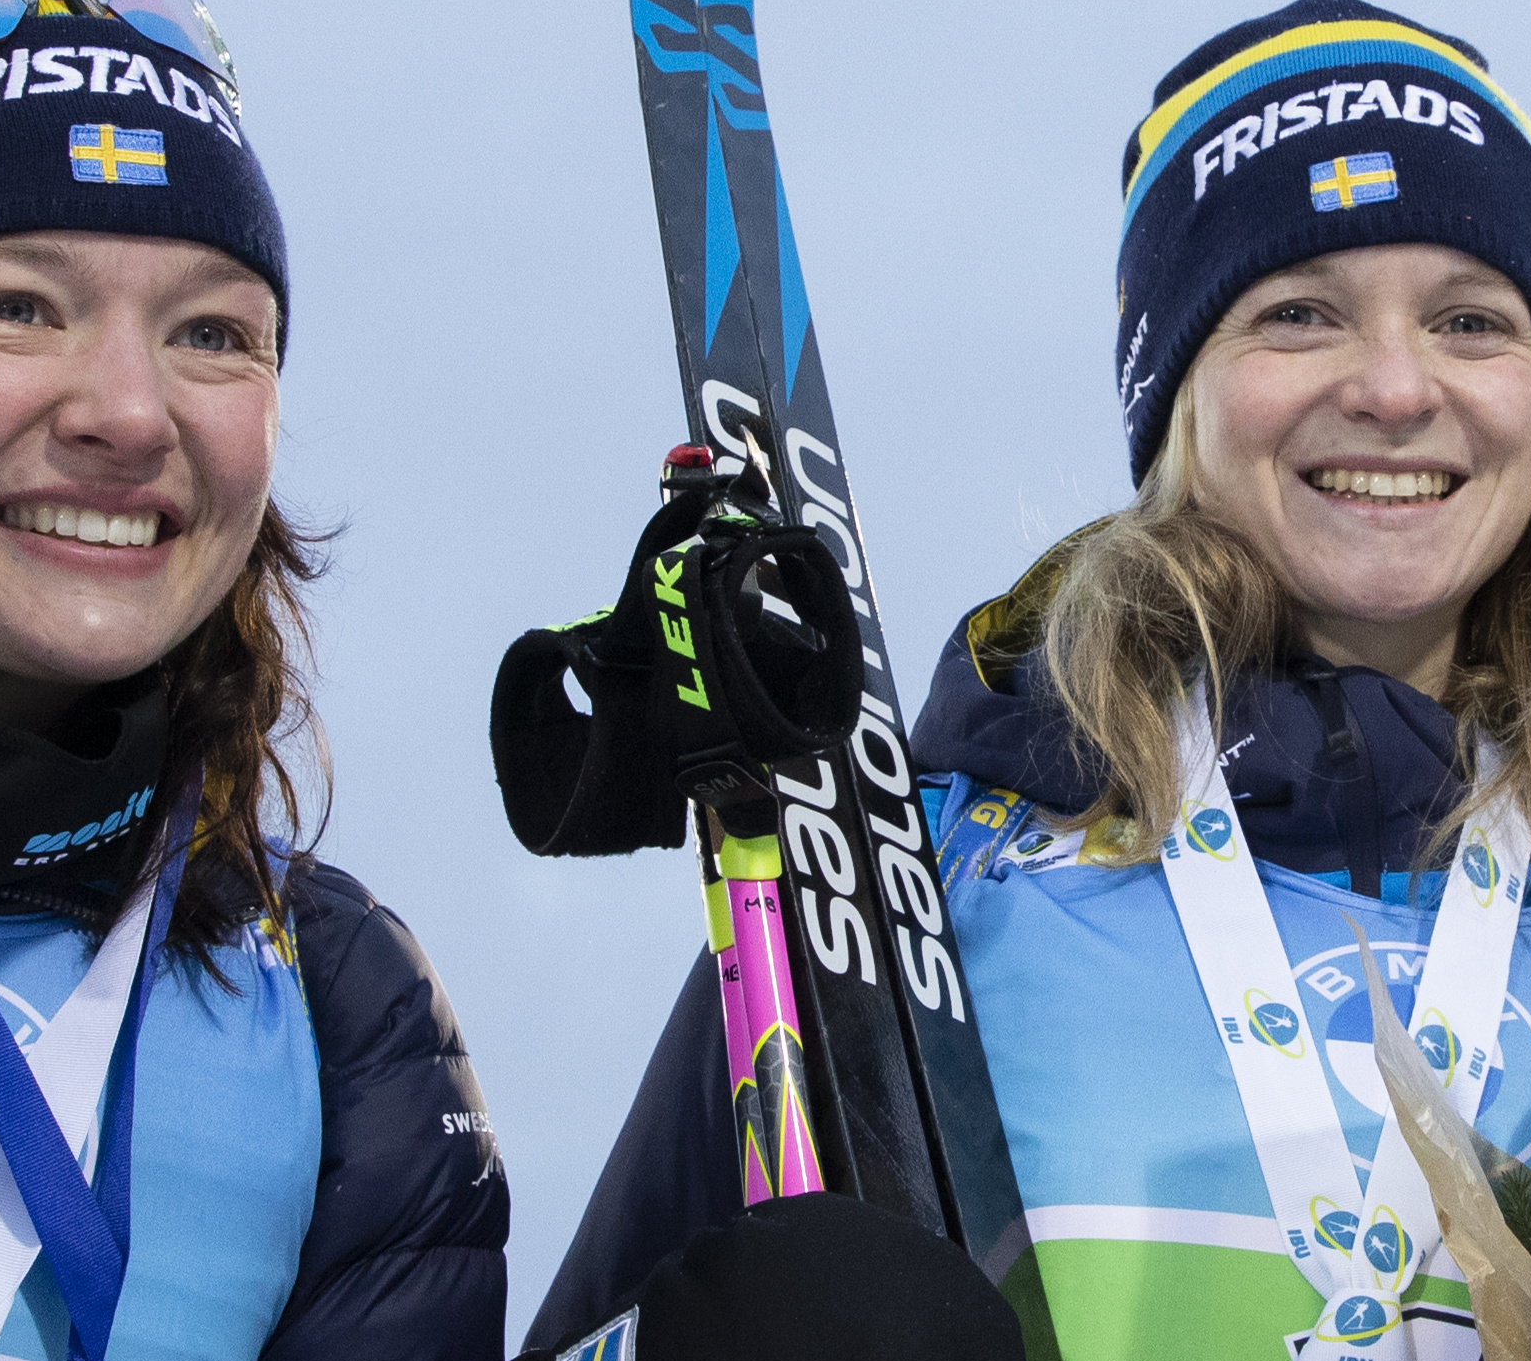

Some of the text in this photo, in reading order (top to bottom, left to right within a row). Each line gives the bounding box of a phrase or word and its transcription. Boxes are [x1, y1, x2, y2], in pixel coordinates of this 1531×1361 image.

[1193, 80, 1484, 203] FRISTADS
[1506, 874, 1520, 904] IBU
[1222, 1017, 1243, 1044] IBU
[1468, 1047, 1486, 1081] IBU
[1287, 1230, 1310, 1259] IBU
